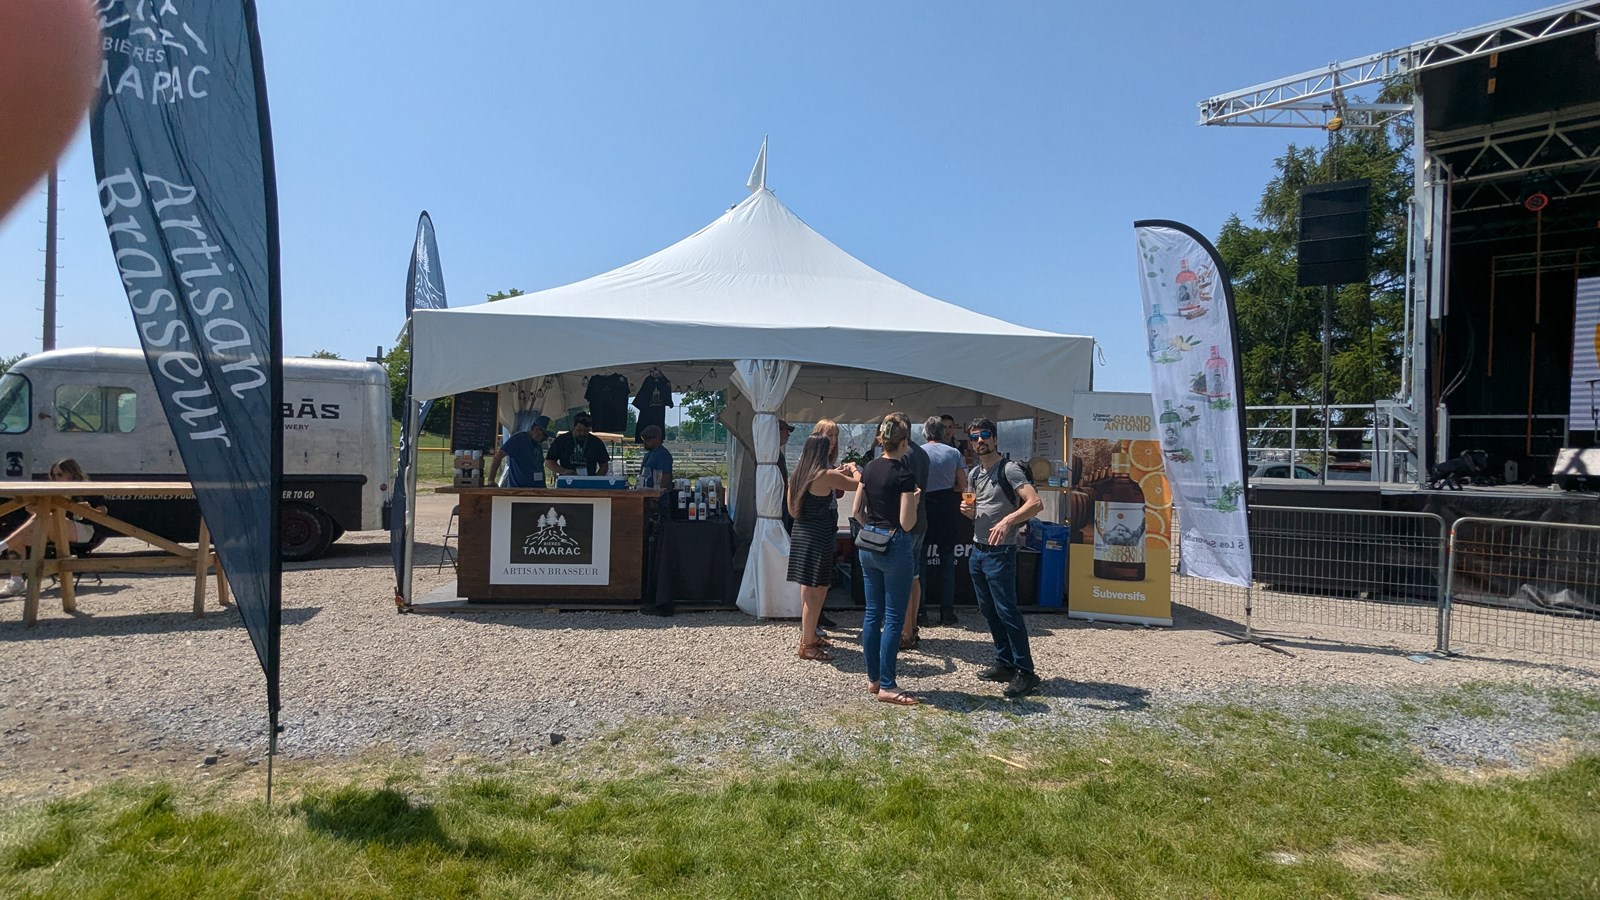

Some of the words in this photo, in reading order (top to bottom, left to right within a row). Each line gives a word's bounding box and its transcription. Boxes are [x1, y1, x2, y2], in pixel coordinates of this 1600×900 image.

[143, 171, 267, 400] Artisan
[97, 167, 231, 448] Brasseur
[1113, 414, 1152, 425] GRAND
[1103, 421, 1152, 432] ANTONIO
[282, 490, 292, 499] ER
[293, 490, 303, 499] TO
[304, 490, 315, 499] GO
[523, 546, 581, 556] TAMARAC
[503, 567, 545, 576] ARTISAN
[548, 567, 599, 576] BRASSEUR
[1092, 586, 1146, 601] Subversifs
